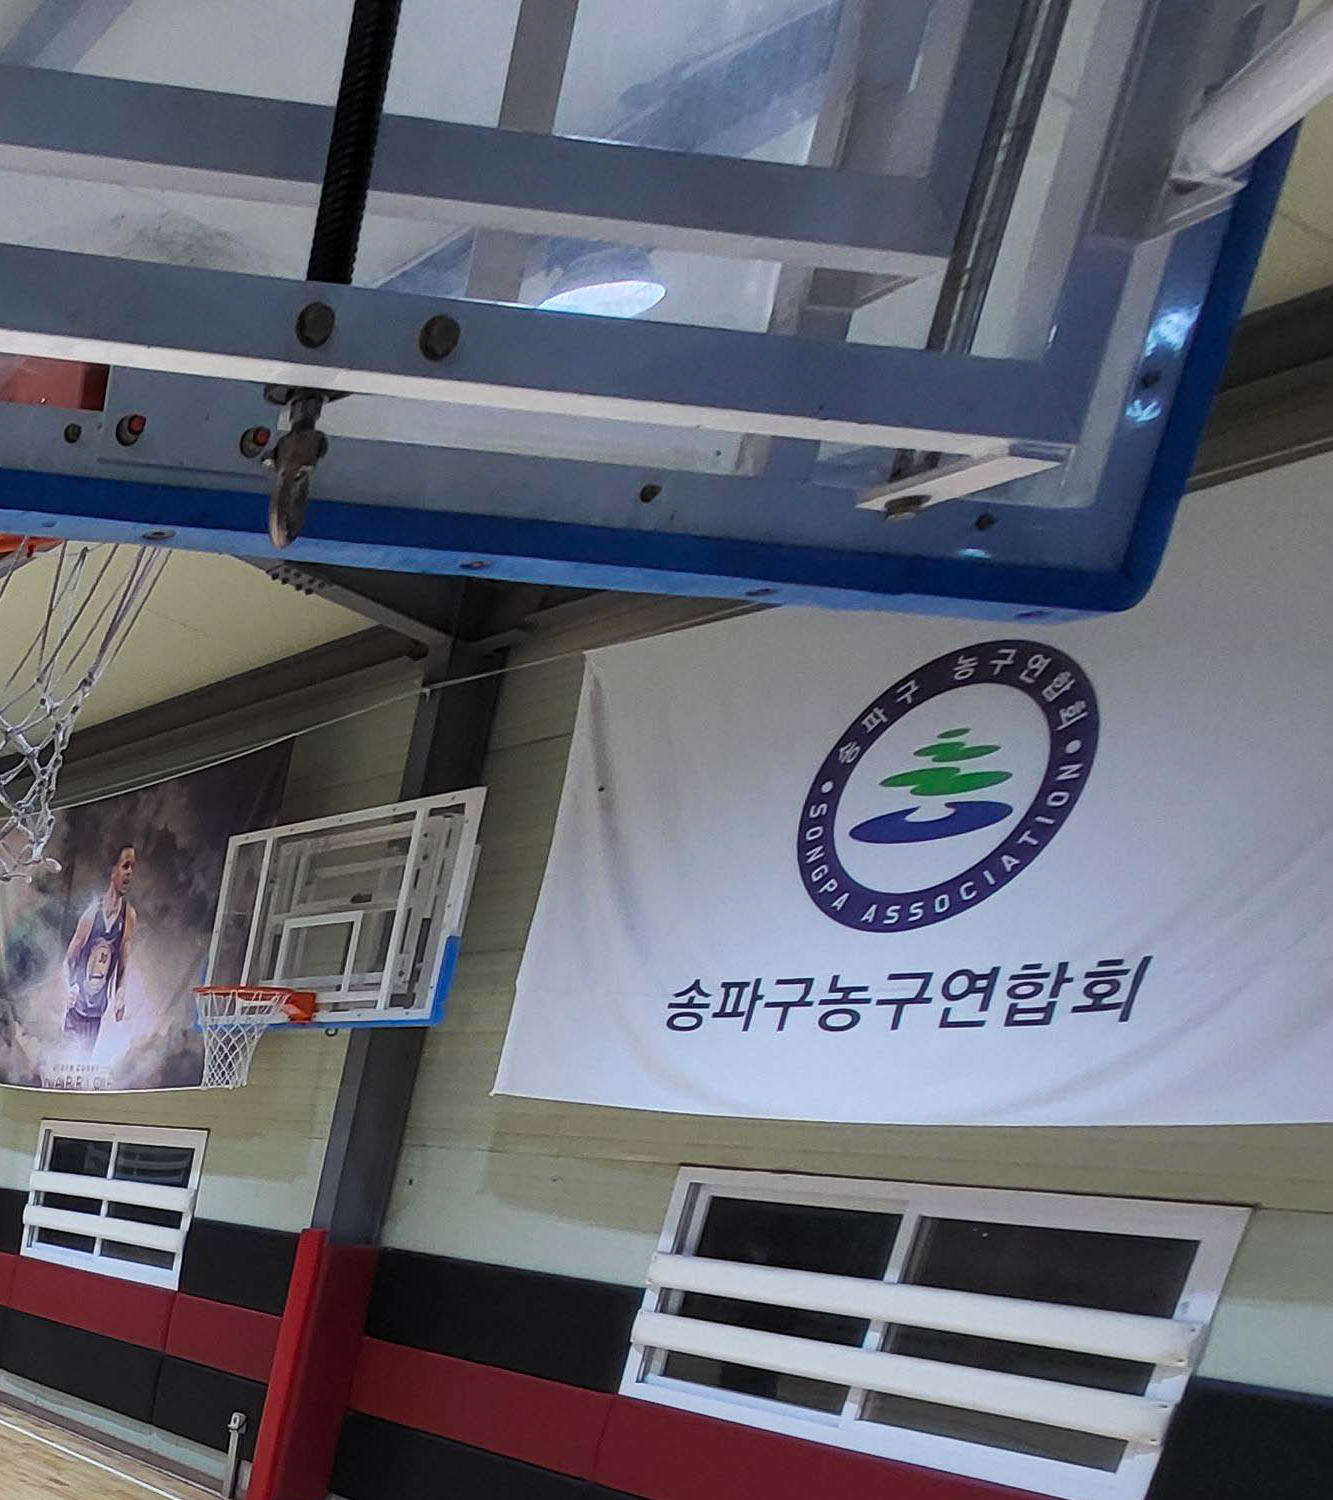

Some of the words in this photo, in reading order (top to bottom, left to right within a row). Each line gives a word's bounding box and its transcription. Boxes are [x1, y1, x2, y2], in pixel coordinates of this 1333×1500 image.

[838, 679, 920, 765] 송파구
[952, 649, 1089, 731] 농구연합회
[804, 802, 851, 912] SONGPA
[860, 762, 1083, 925] ASSOCIATION
[665, 954, 1154, 1033] 송파구농구연합회
